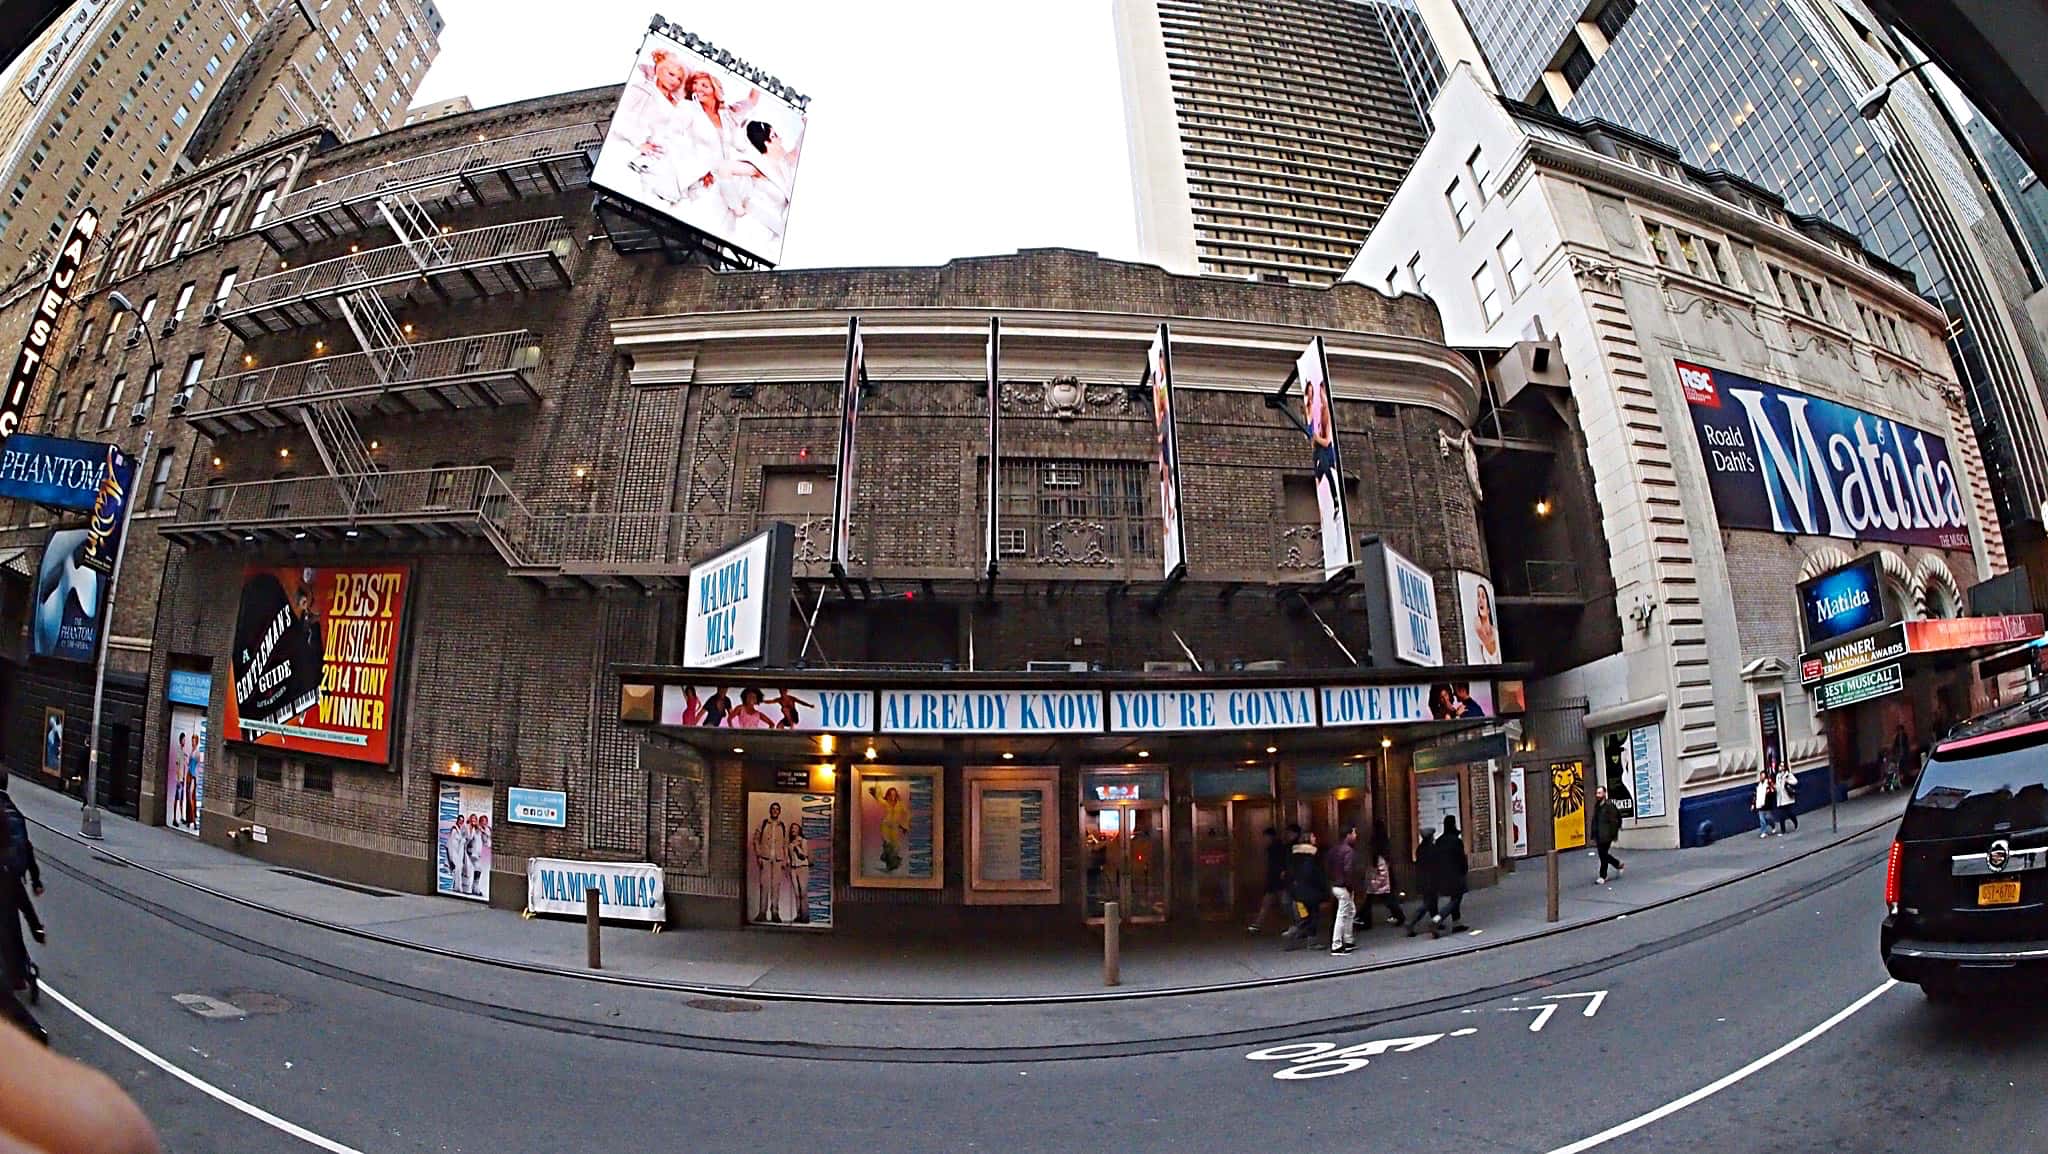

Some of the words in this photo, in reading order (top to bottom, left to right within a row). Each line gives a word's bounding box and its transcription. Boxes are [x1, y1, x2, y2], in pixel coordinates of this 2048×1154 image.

[0, 210, 98, 437] MAJESTIC
[1679, 367, 1713, 392] RSC
[1704, 424, 1744, 447] Roald
[0, 450, 106, 492] PHANTOM
[1712, 450, 1755, 473] Dahl's
[1729, 388, 1969, 538] Matilda
[329, 573, 401, 618] BEST
[698, 556, 749, 616] MAMMA
[1396, 565, 1432, 620] MAMMA
[1816, 587, 1870, 623] Matilda
[322, 618, 393, 664] MUSICAL!
[705, 605, 736, 657] MIA!
[1824, 637, 1876, 662] WINNER!
[236, 604, 292, 704] GENTLEMAN'S
[242, 648, 250, 663] A
[1871, 642, 1904, 660] AWARDS
[258, 660, 292, 693] GUIDE
[320, 664, 350, 692] 2014
[354, 666, 388, 696] TONY
[1847, 669, 1893, 692] MUSICAL!
[319, 695, 385, 730] WINNER
[819, 691, 868, 727] YOU
[884, 693, 1010, 729] ALREADY
[1020, 693, 1099, 729] KNOW
[1115, 691, 1215, 728] YOU'RE
[1229, 690, 1311, 726] GONNA
[1322, 686, 1381, 722] LOVE
[1389, 685, 1422, 719] IT!
[541, 869, 610, 905] MAMMA
[614, 874, 656, 908] MIA!
